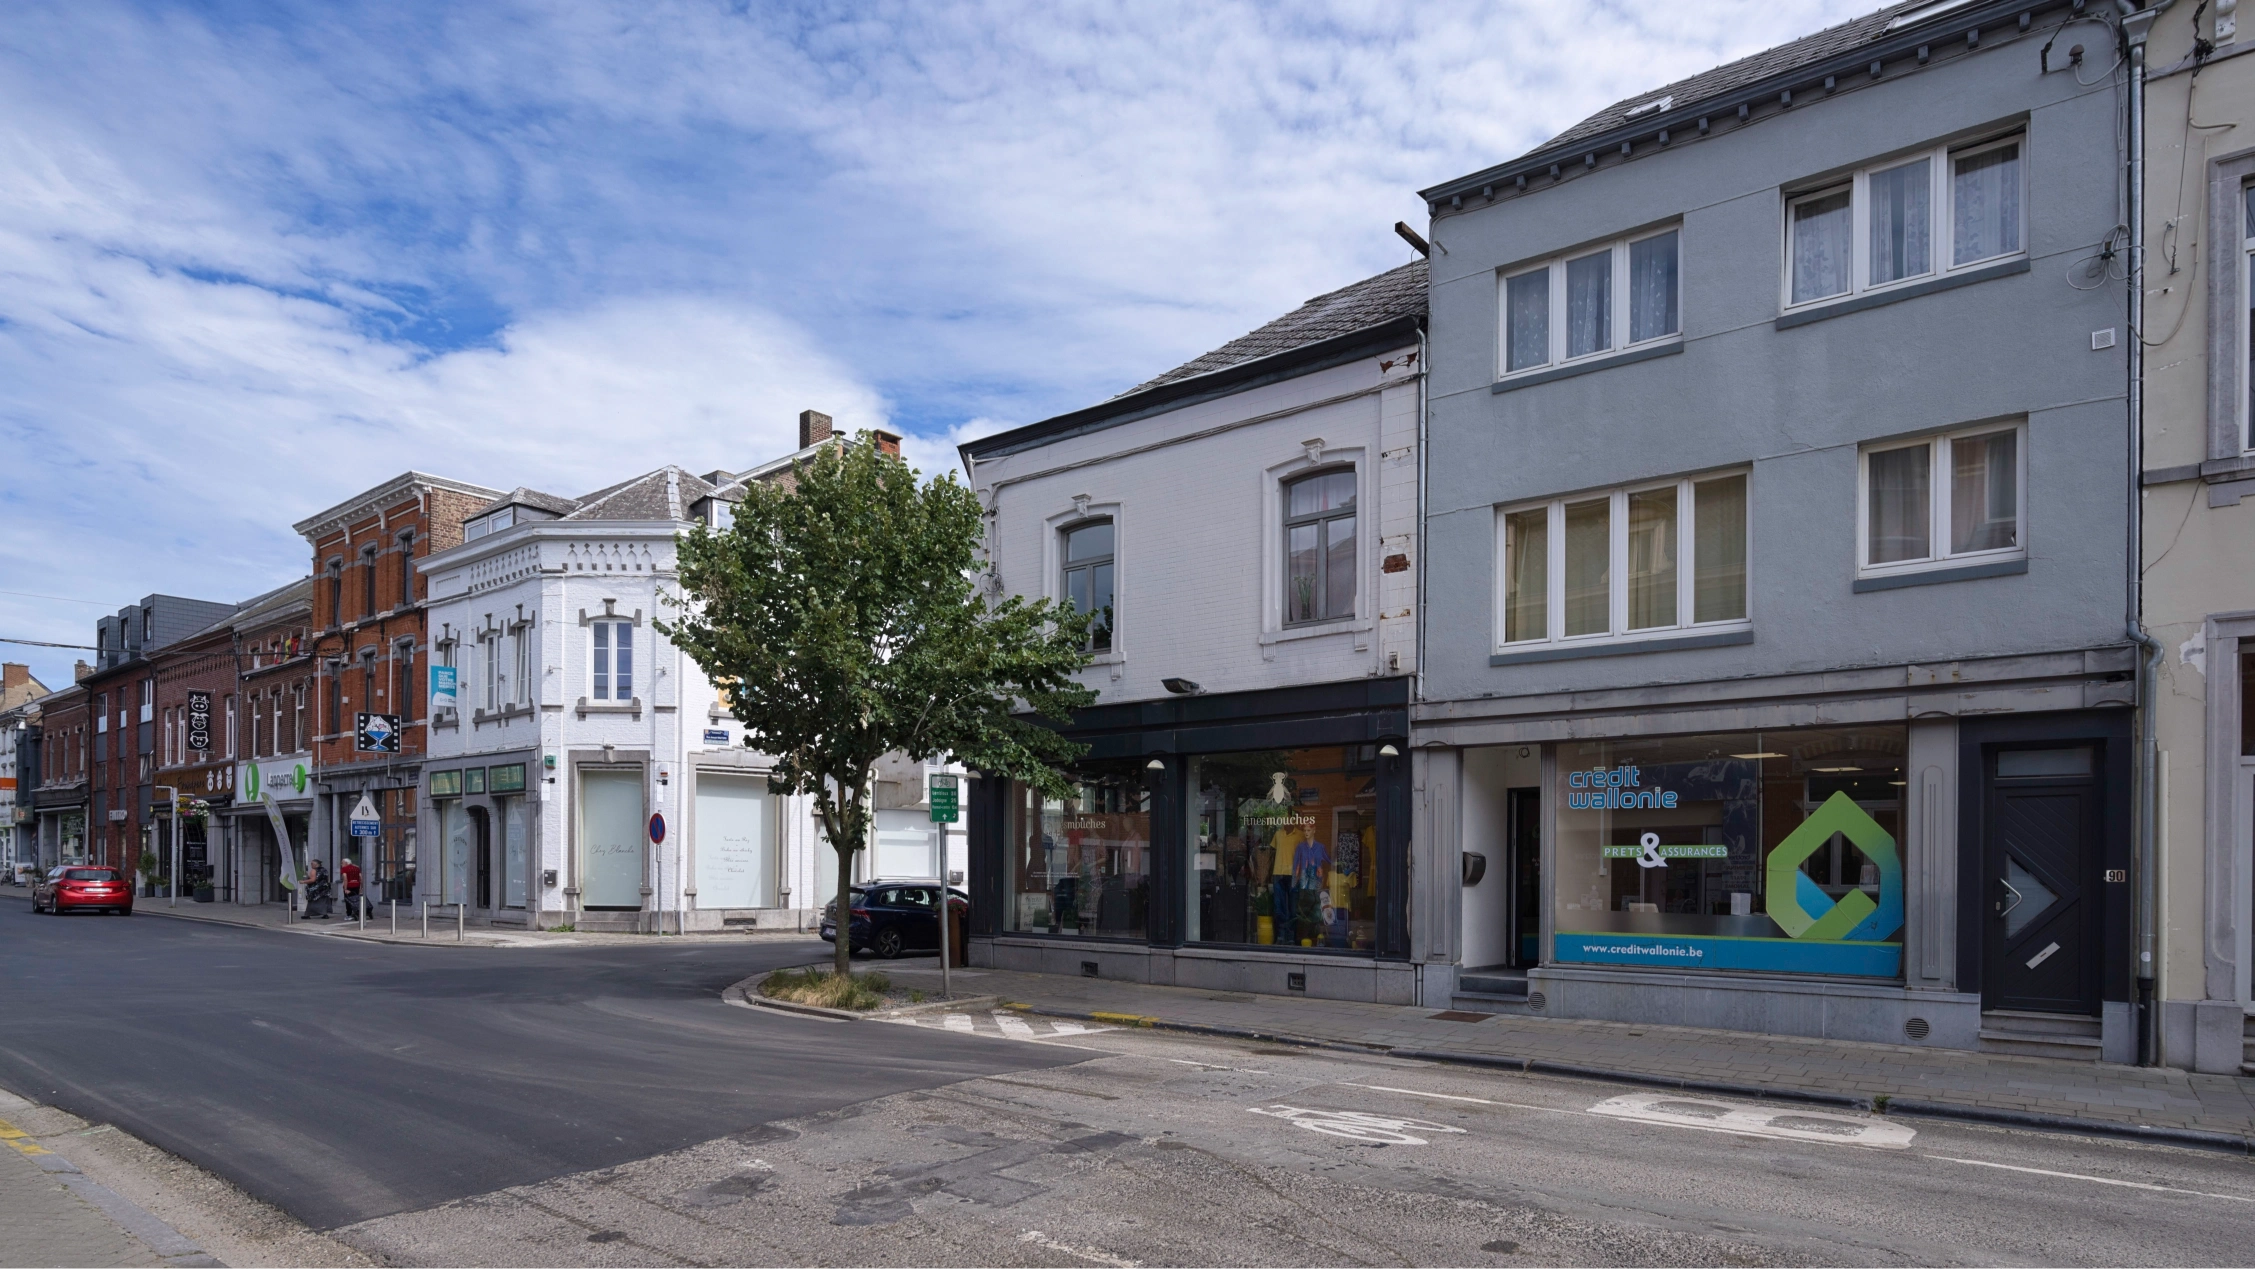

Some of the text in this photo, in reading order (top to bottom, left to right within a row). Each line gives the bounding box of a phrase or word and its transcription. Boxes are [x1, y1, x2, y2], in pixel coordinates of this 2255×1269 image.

[1568, 786, 1678, 809] wallonie
[1243, 813, 1316, 826] finesmouches
[1604, 832, 1728, 868] PRETS & ASSURANCES
[2108, 870, 2123, 881] 90
[1582, 943, 1703, 957] www.creditwallonie.be
